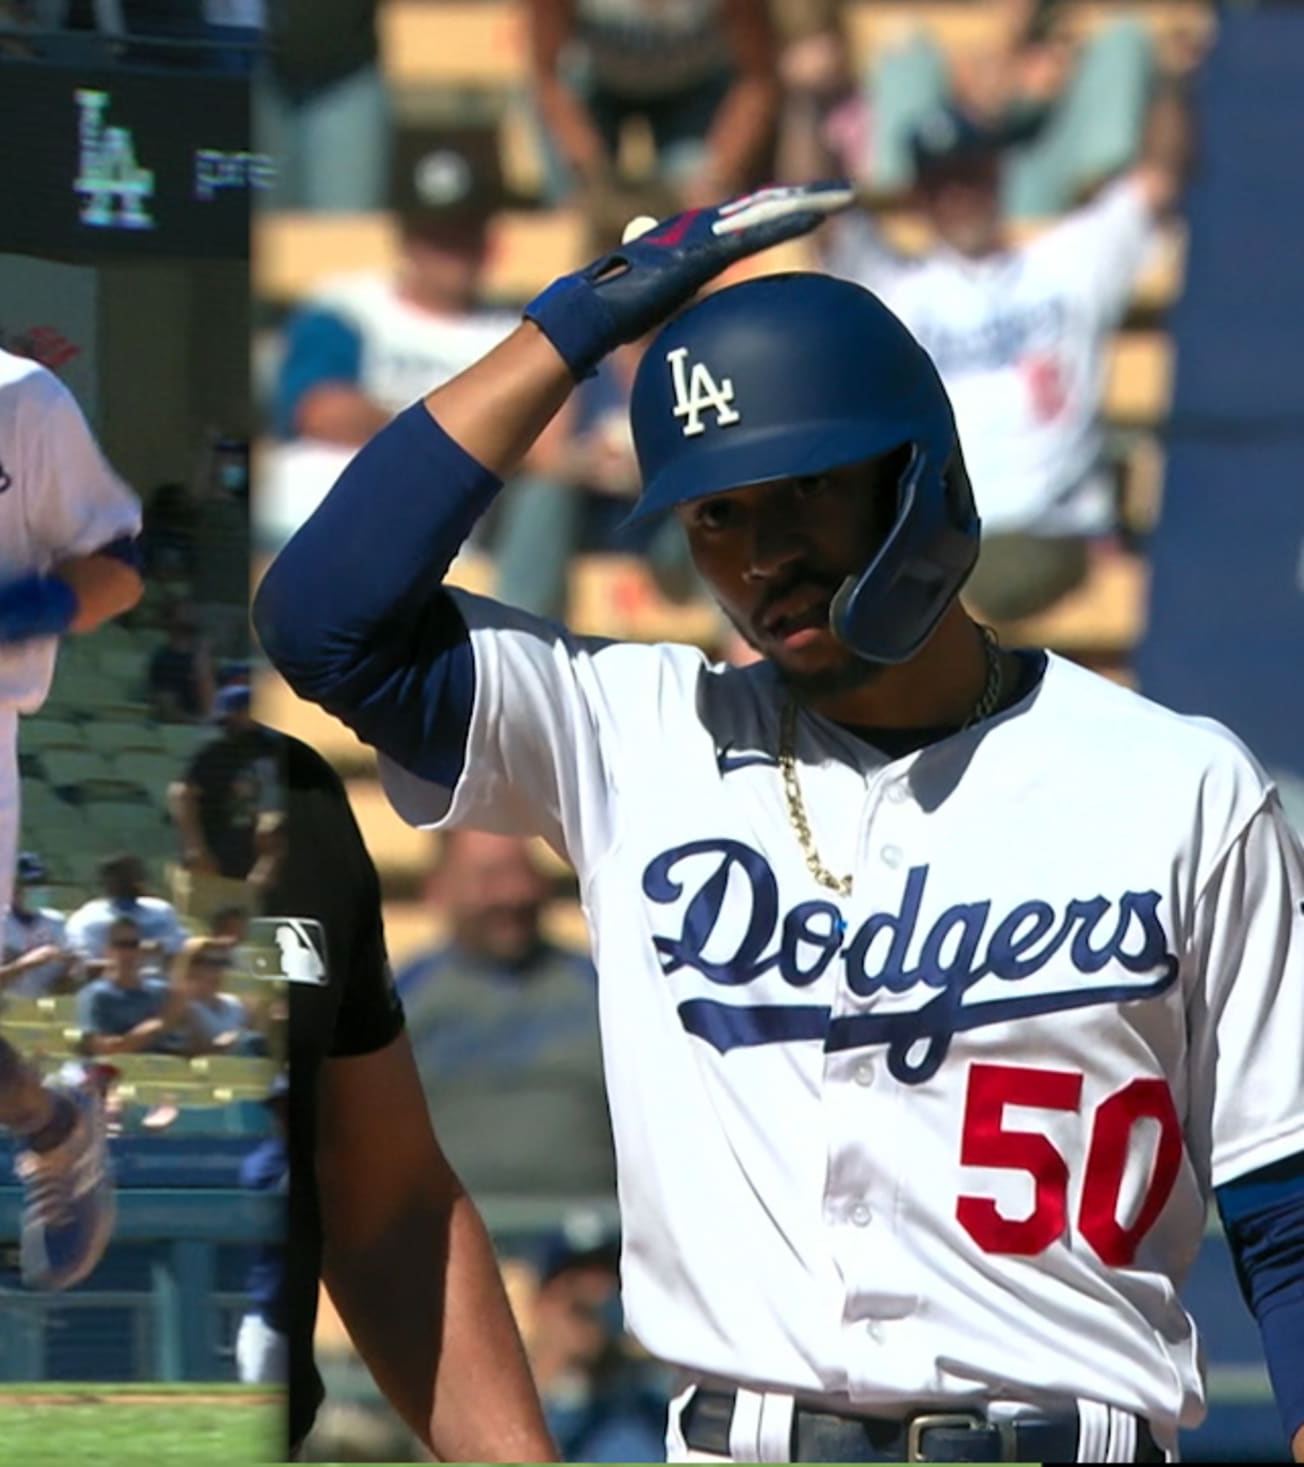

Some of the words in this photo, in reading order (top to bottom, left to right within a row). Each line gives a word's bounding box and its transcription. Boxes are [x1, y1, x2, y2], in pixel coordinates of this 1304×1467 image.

[666, 347, 740, 437] LA
[642, 838, 1179, 1086] Dodgers
[954, 1062, 1184, 1268] 50
